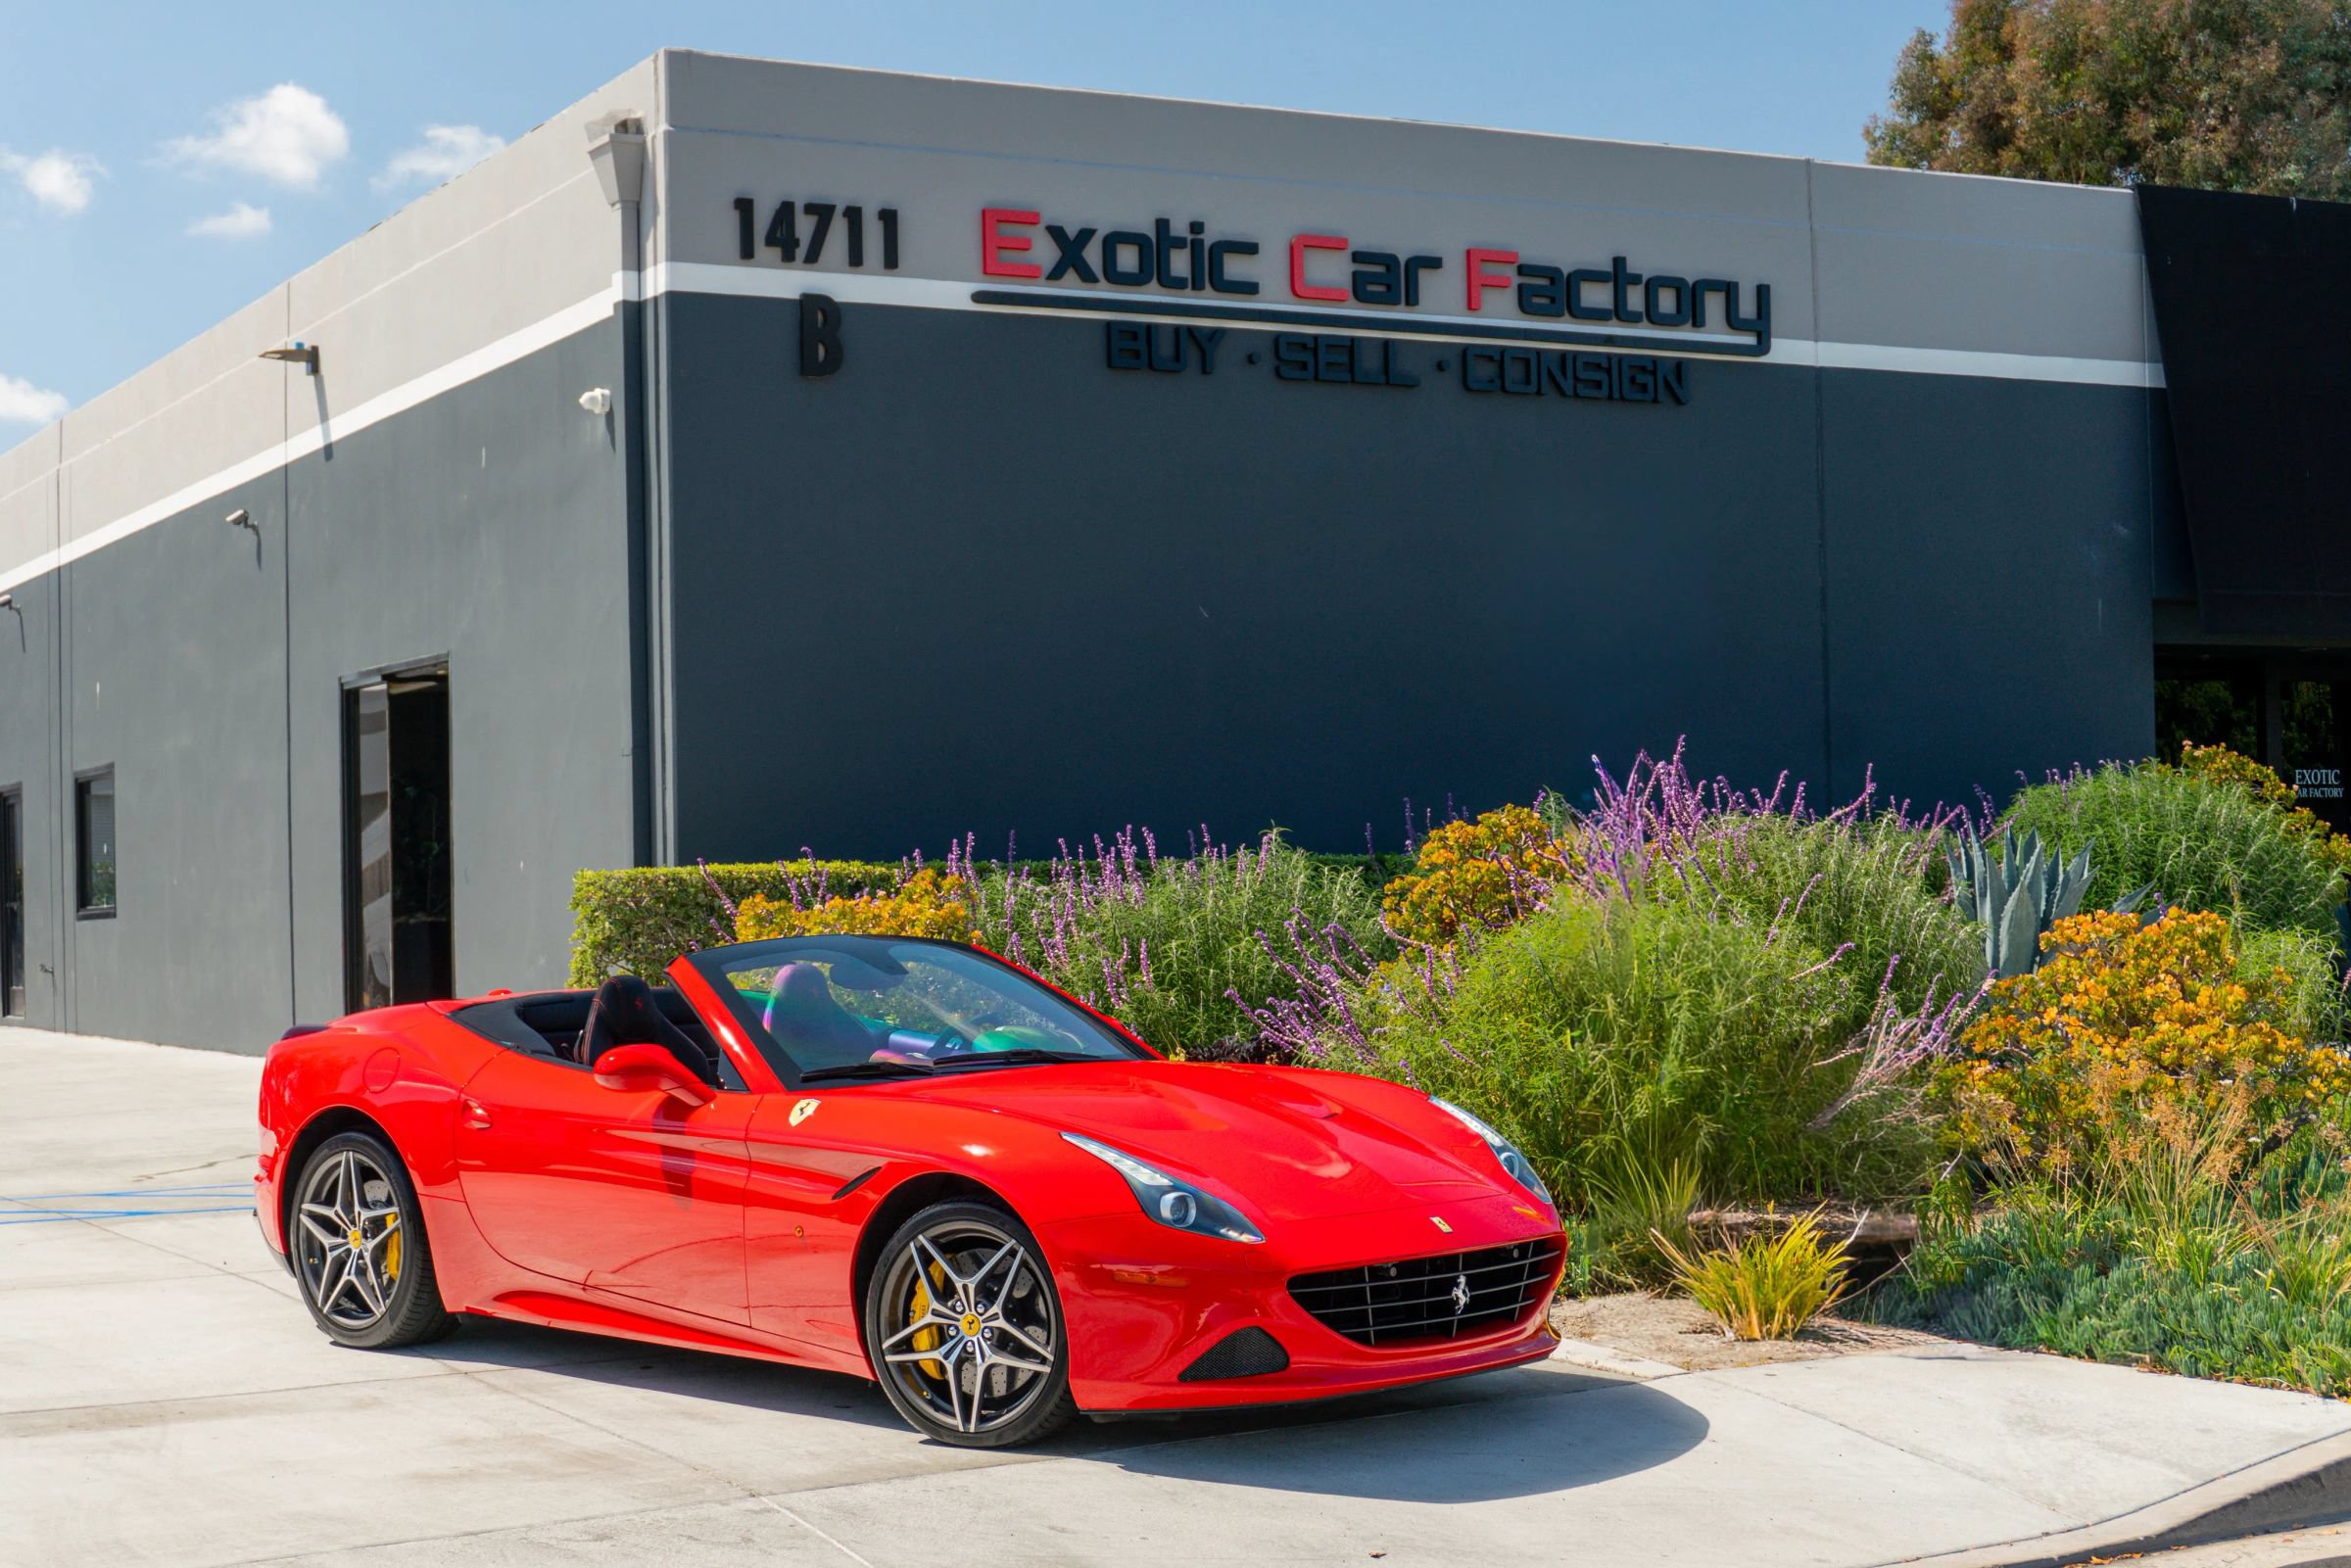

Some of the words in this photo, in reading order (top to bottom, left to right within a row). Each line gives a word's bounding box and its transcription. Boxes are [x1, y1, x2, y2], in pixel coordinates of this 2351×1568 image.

[734, 197, 898, 269] 14711
[982, 208, 1260, 295] Exotic
[1290, 234, 1443, 307] Car
[1465, 248, 1771, 356] Factory
[799, 292, 844, 378] B
[1106, 320, 1226, 375] BUY
[1274, 333, 1420, 388] SELL
[1463, 346, 1691, 405] CONSIGN
[2295, 769, 2340, 784] EXOTIC
[2296, 787, 2308, 798] AR
[2309, 787, 2344, 798] FACTORY
